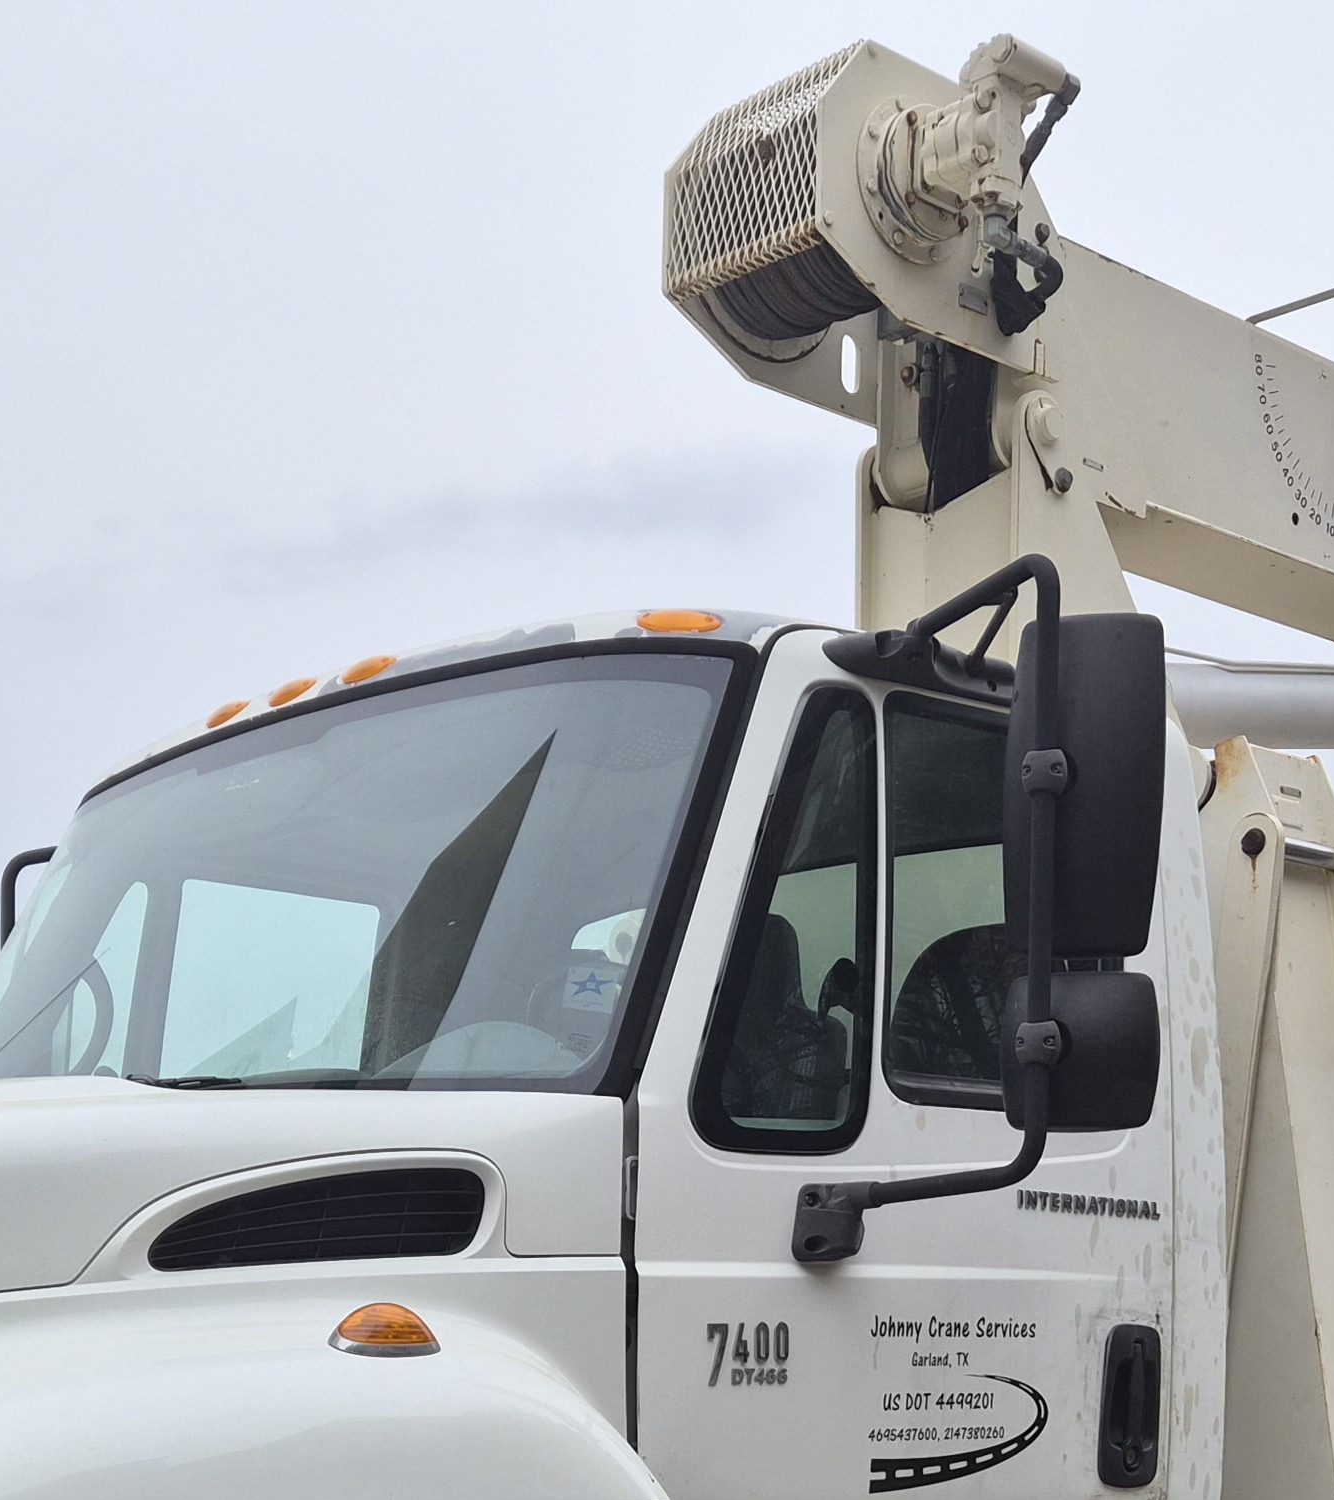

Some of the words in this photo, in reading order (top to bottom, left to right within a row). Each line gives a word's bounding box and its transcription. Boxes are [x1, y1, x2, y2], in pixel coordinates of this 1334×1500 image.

[1257, 384, 1267, 405] 70
[1263, 413, 1274, 435] 60
[1272, 441, 1283, 462] 50
[1282, 468, 1294, 486] 40
[1295, 489, 1307, 508] 30
[1309, 508, 1321, 525] 20
[1017, 1189, 1161, 1221] INTERNATIONAL
[870, 1315, 923, 1343] Johnny
[928, 1315, 971, 1338] Crane
[976, 1316, 1037, 1338] Services
[707, 1321, 789, 1387] 7400
[911, 1351, 952, 1369] Garland,
[956, 1352, 969, 1367] TX
[731, 1368, 788, 1386] DT466
[882, 1393, 901, 1411] US
[905, 1392, 931, 1411] DOT
[935, 1392, 994, 1410] 4499201
[868, 1427, 940, 1442] 4695437600,
[943, 1426, 1005, 1440] 2147380260
